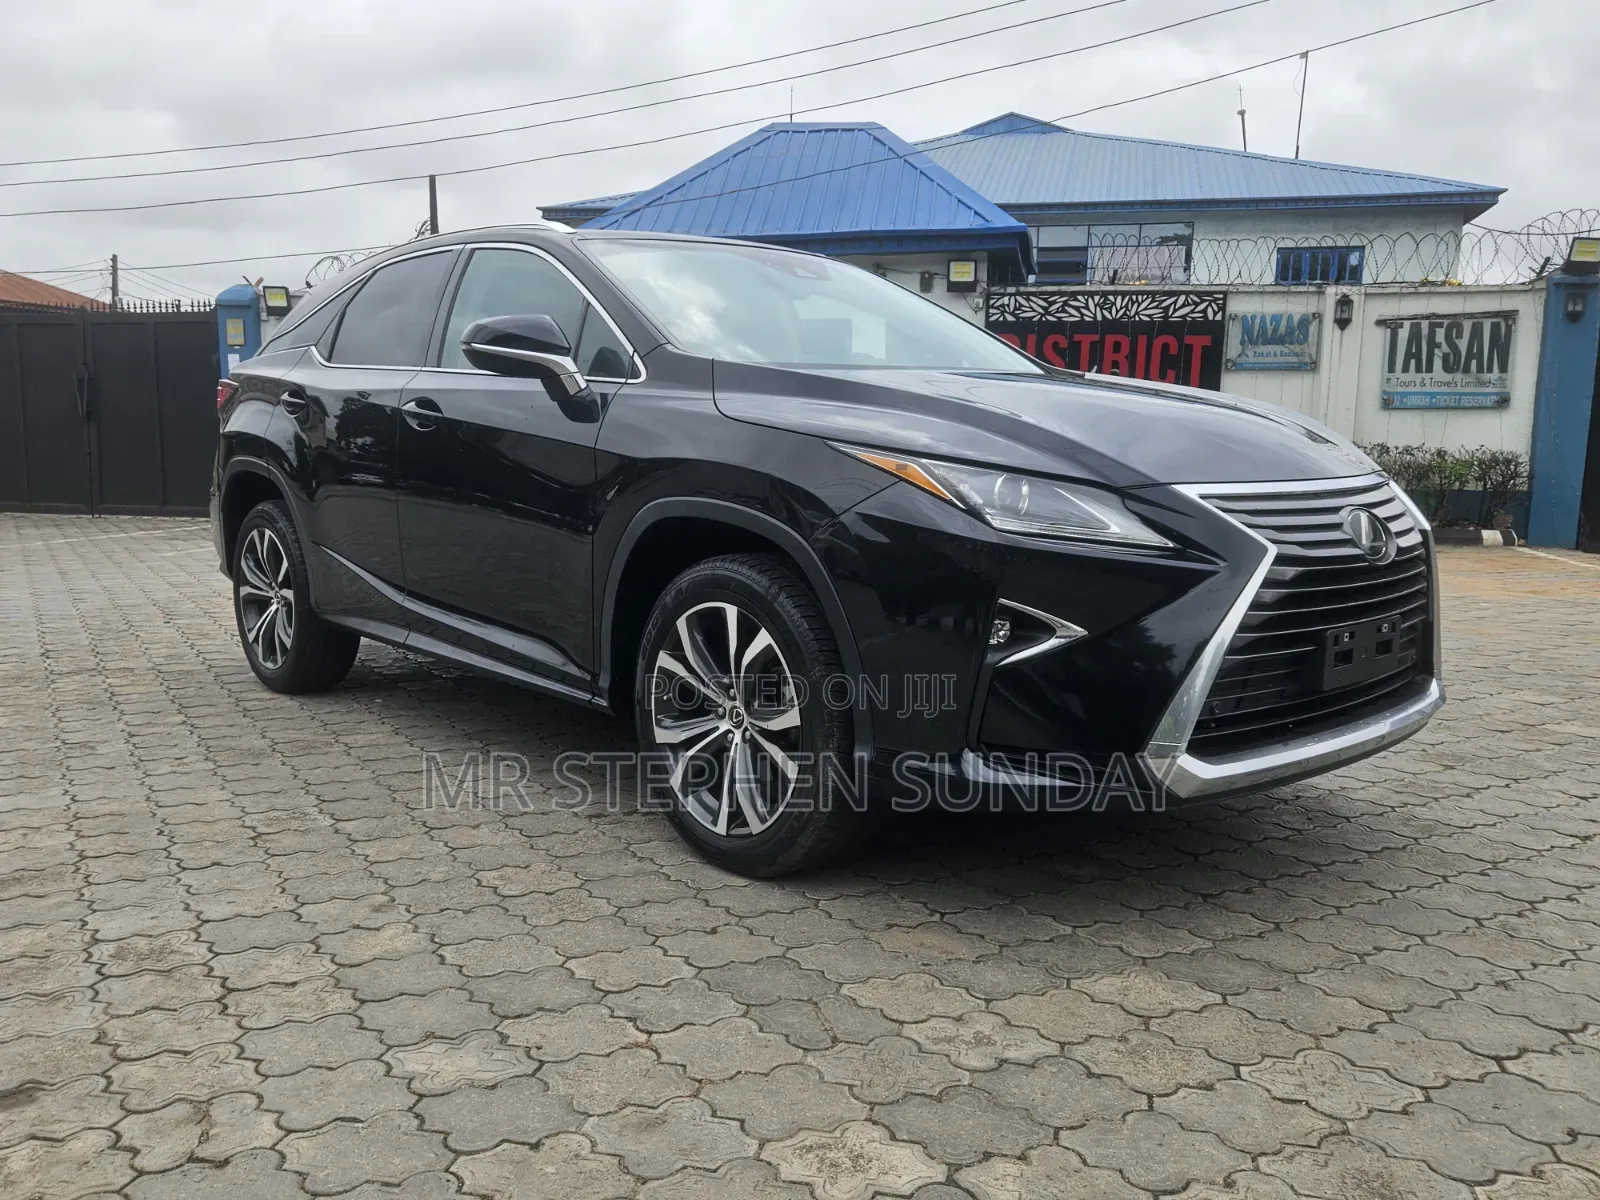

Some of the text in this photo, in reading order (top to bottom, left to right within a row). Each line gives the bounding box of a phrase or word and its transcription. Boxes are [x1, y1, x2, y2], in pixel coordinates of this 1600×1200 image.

[1240, 313, 1310, 345] NAZAS
[1387, 321, 1513, 374] TAFSAN
[1395, 376, 1491, 388] Tours & Travels Limited
